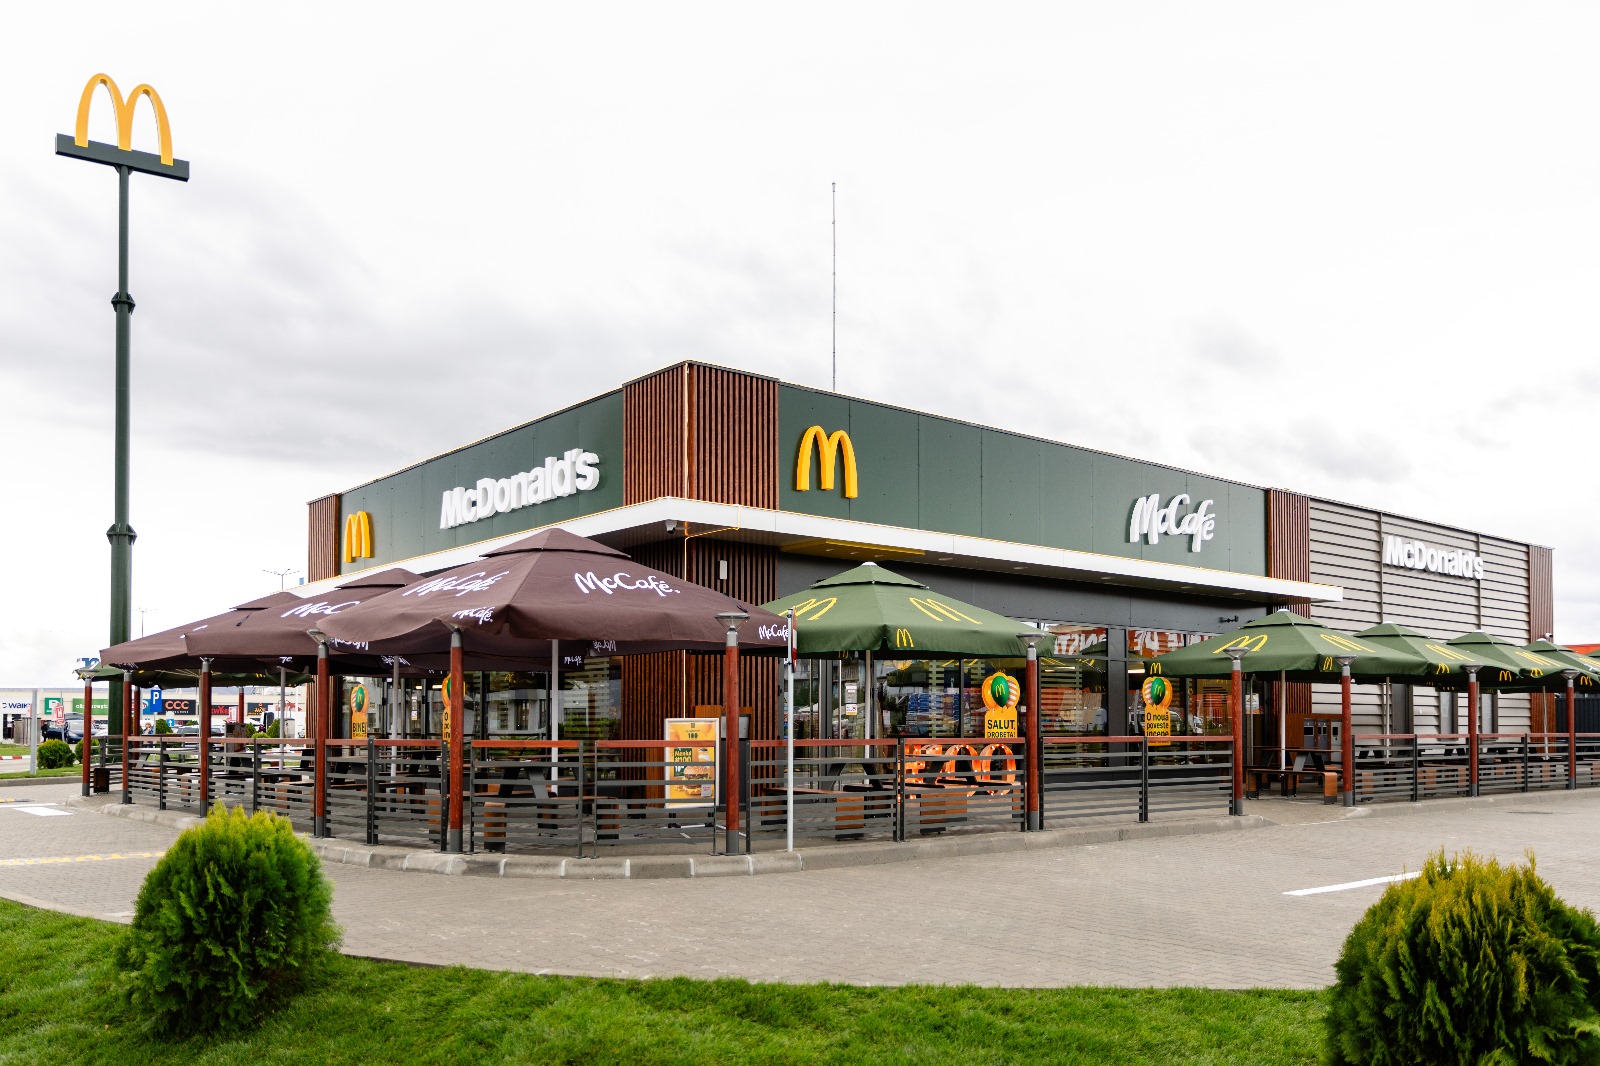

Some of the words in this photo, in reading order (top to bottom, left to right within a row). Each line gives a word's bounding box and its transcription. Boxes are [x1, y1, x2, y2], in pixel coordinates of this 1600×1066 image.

[74, 73, 173, 167] M
[796, 425, 858, 499] M
[440, 448, 600, 530] McDonald's
[343, 510, 374, 563] M
[1129, 493, 1216, 553] McCafé
[1383, 535, 1484, 580] McDonald's
[574, 571, 680, 597] McCafé
[280, 600, 360, 618] McC
[153, 691, 160, 705] P
[165, 700, 190, 710] CCC
[987, 719, 1016, 730] SALUT,
[1146, 722, 1169, 731] poveste
